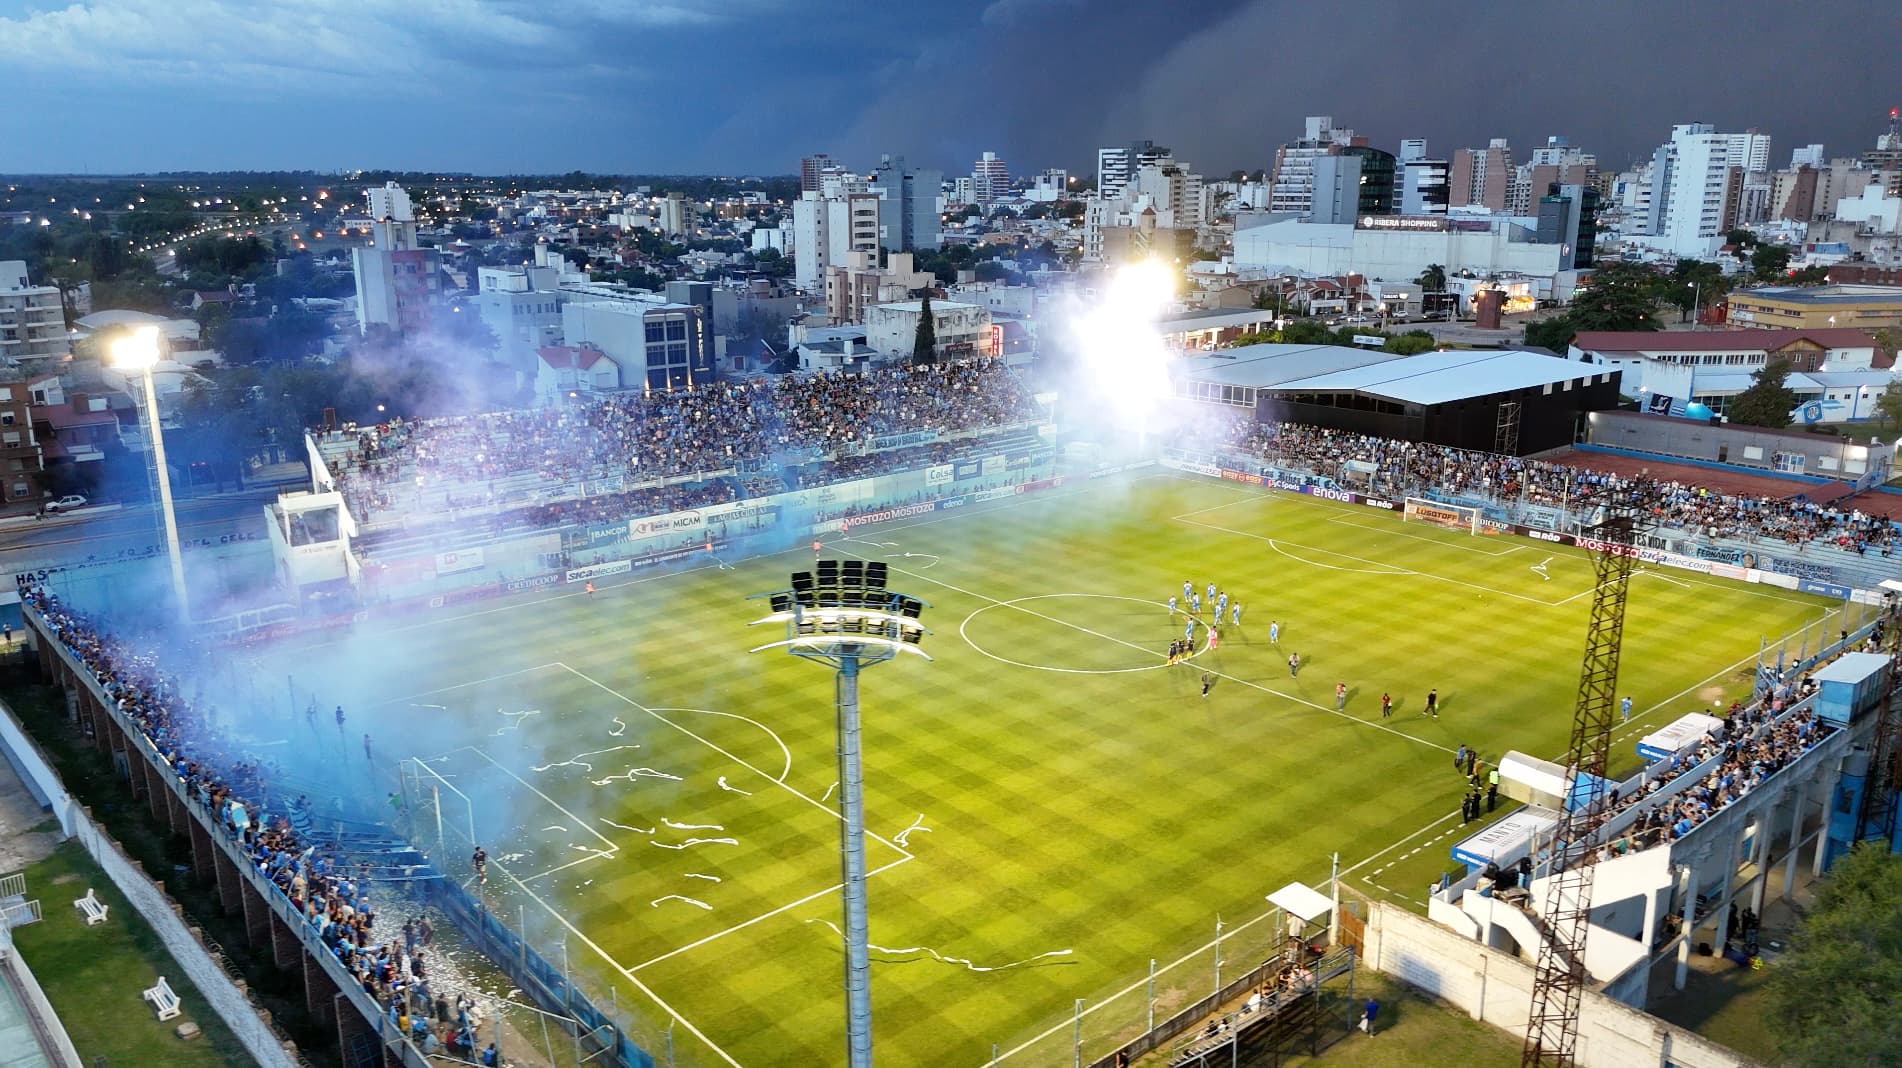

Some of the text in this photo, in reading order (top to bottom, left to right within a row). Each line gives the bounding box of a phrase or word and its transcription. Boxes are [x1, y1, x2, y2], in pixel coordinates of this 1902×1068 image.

[1400, 219, 1437, 227] SHOPPING
[1313, 487, 1349, 502] enova
[673, 517, 700, 528] MICAM
[1465, 515, 1509, 530] CDICOOP
[595, 526, 627, 539] BANCOR
[1648, 535, 1667, 550] VIDA
[507, 574, 559, 591] CREDICOOP
